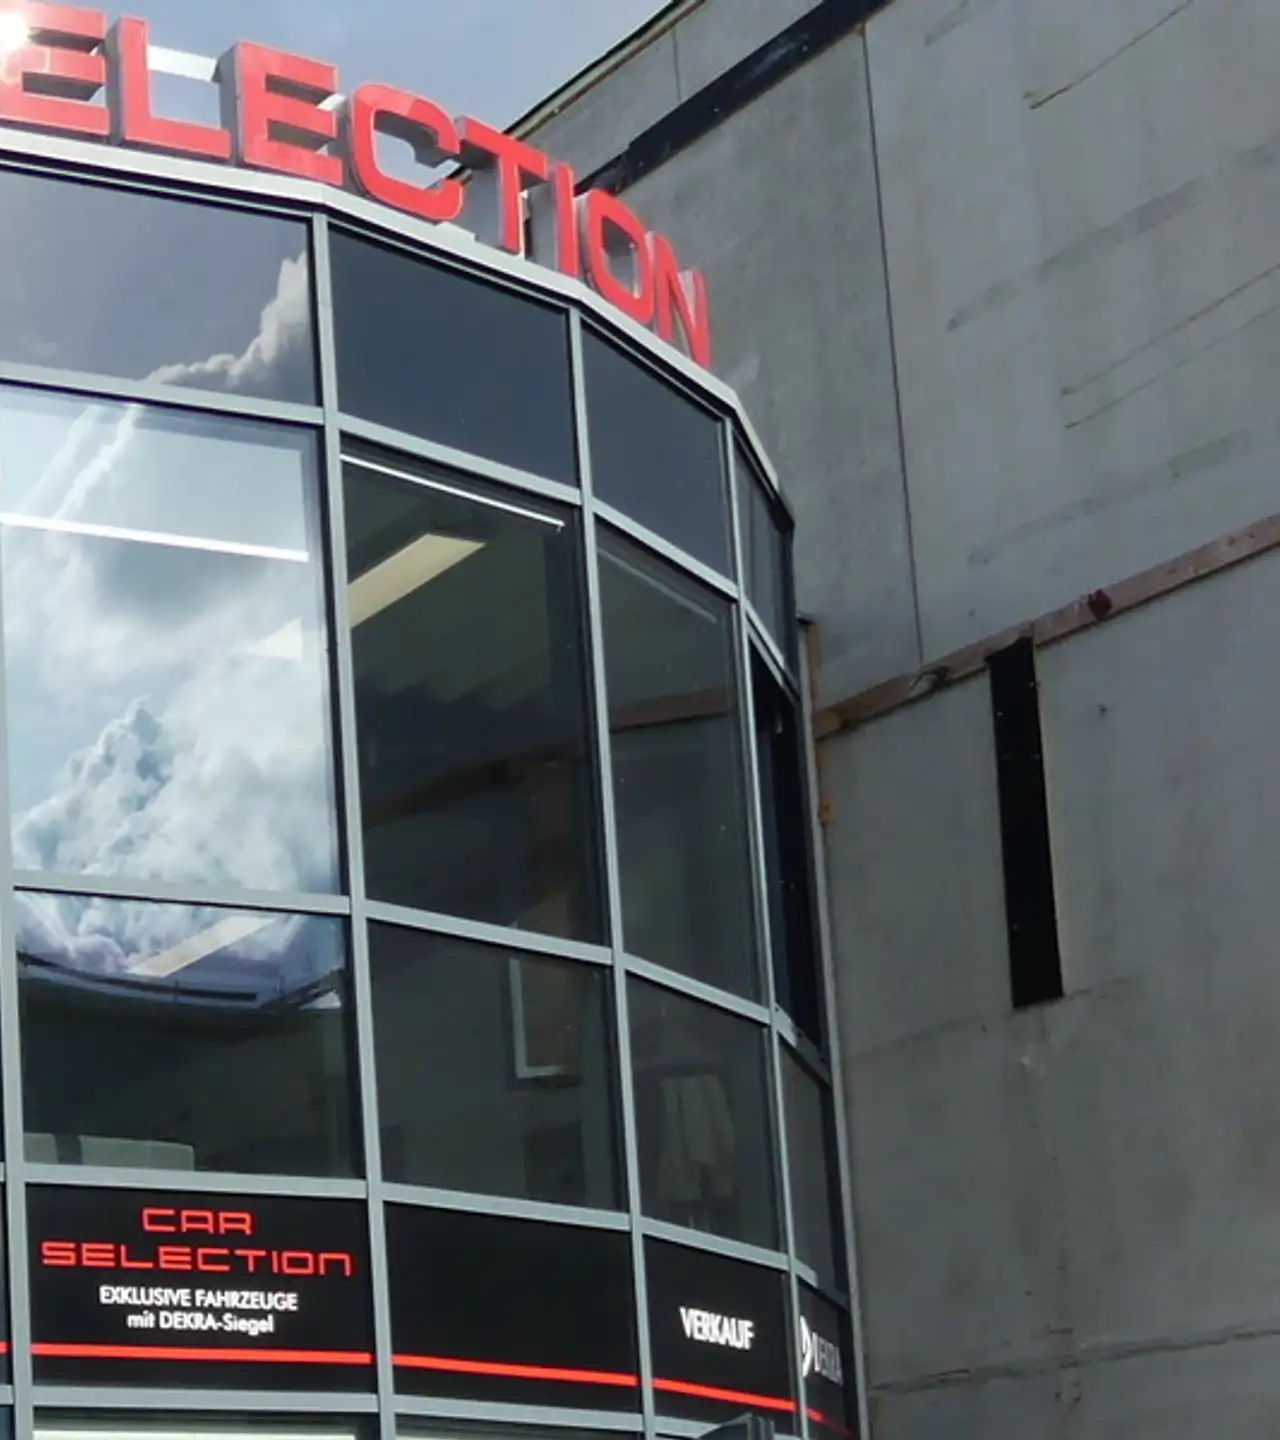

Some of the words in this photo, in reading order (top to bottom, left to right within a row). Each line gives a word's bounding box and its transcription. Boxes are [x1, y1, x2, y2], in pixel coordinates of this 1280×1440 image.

[140, 1206, 256, 1236] CAR
[40, 1240, 355, 1278] SELECTION
[98, 1285, 192, 1308] EXKLUSIVE
[194, 1288, 299, 1312] FAHRZEUGE
[127, 1311, 155, 1329] mit
[158, 1310, 274, 1336] DEKRA-Siegel
[678, 1305, 756, 1351] VERKAUF
